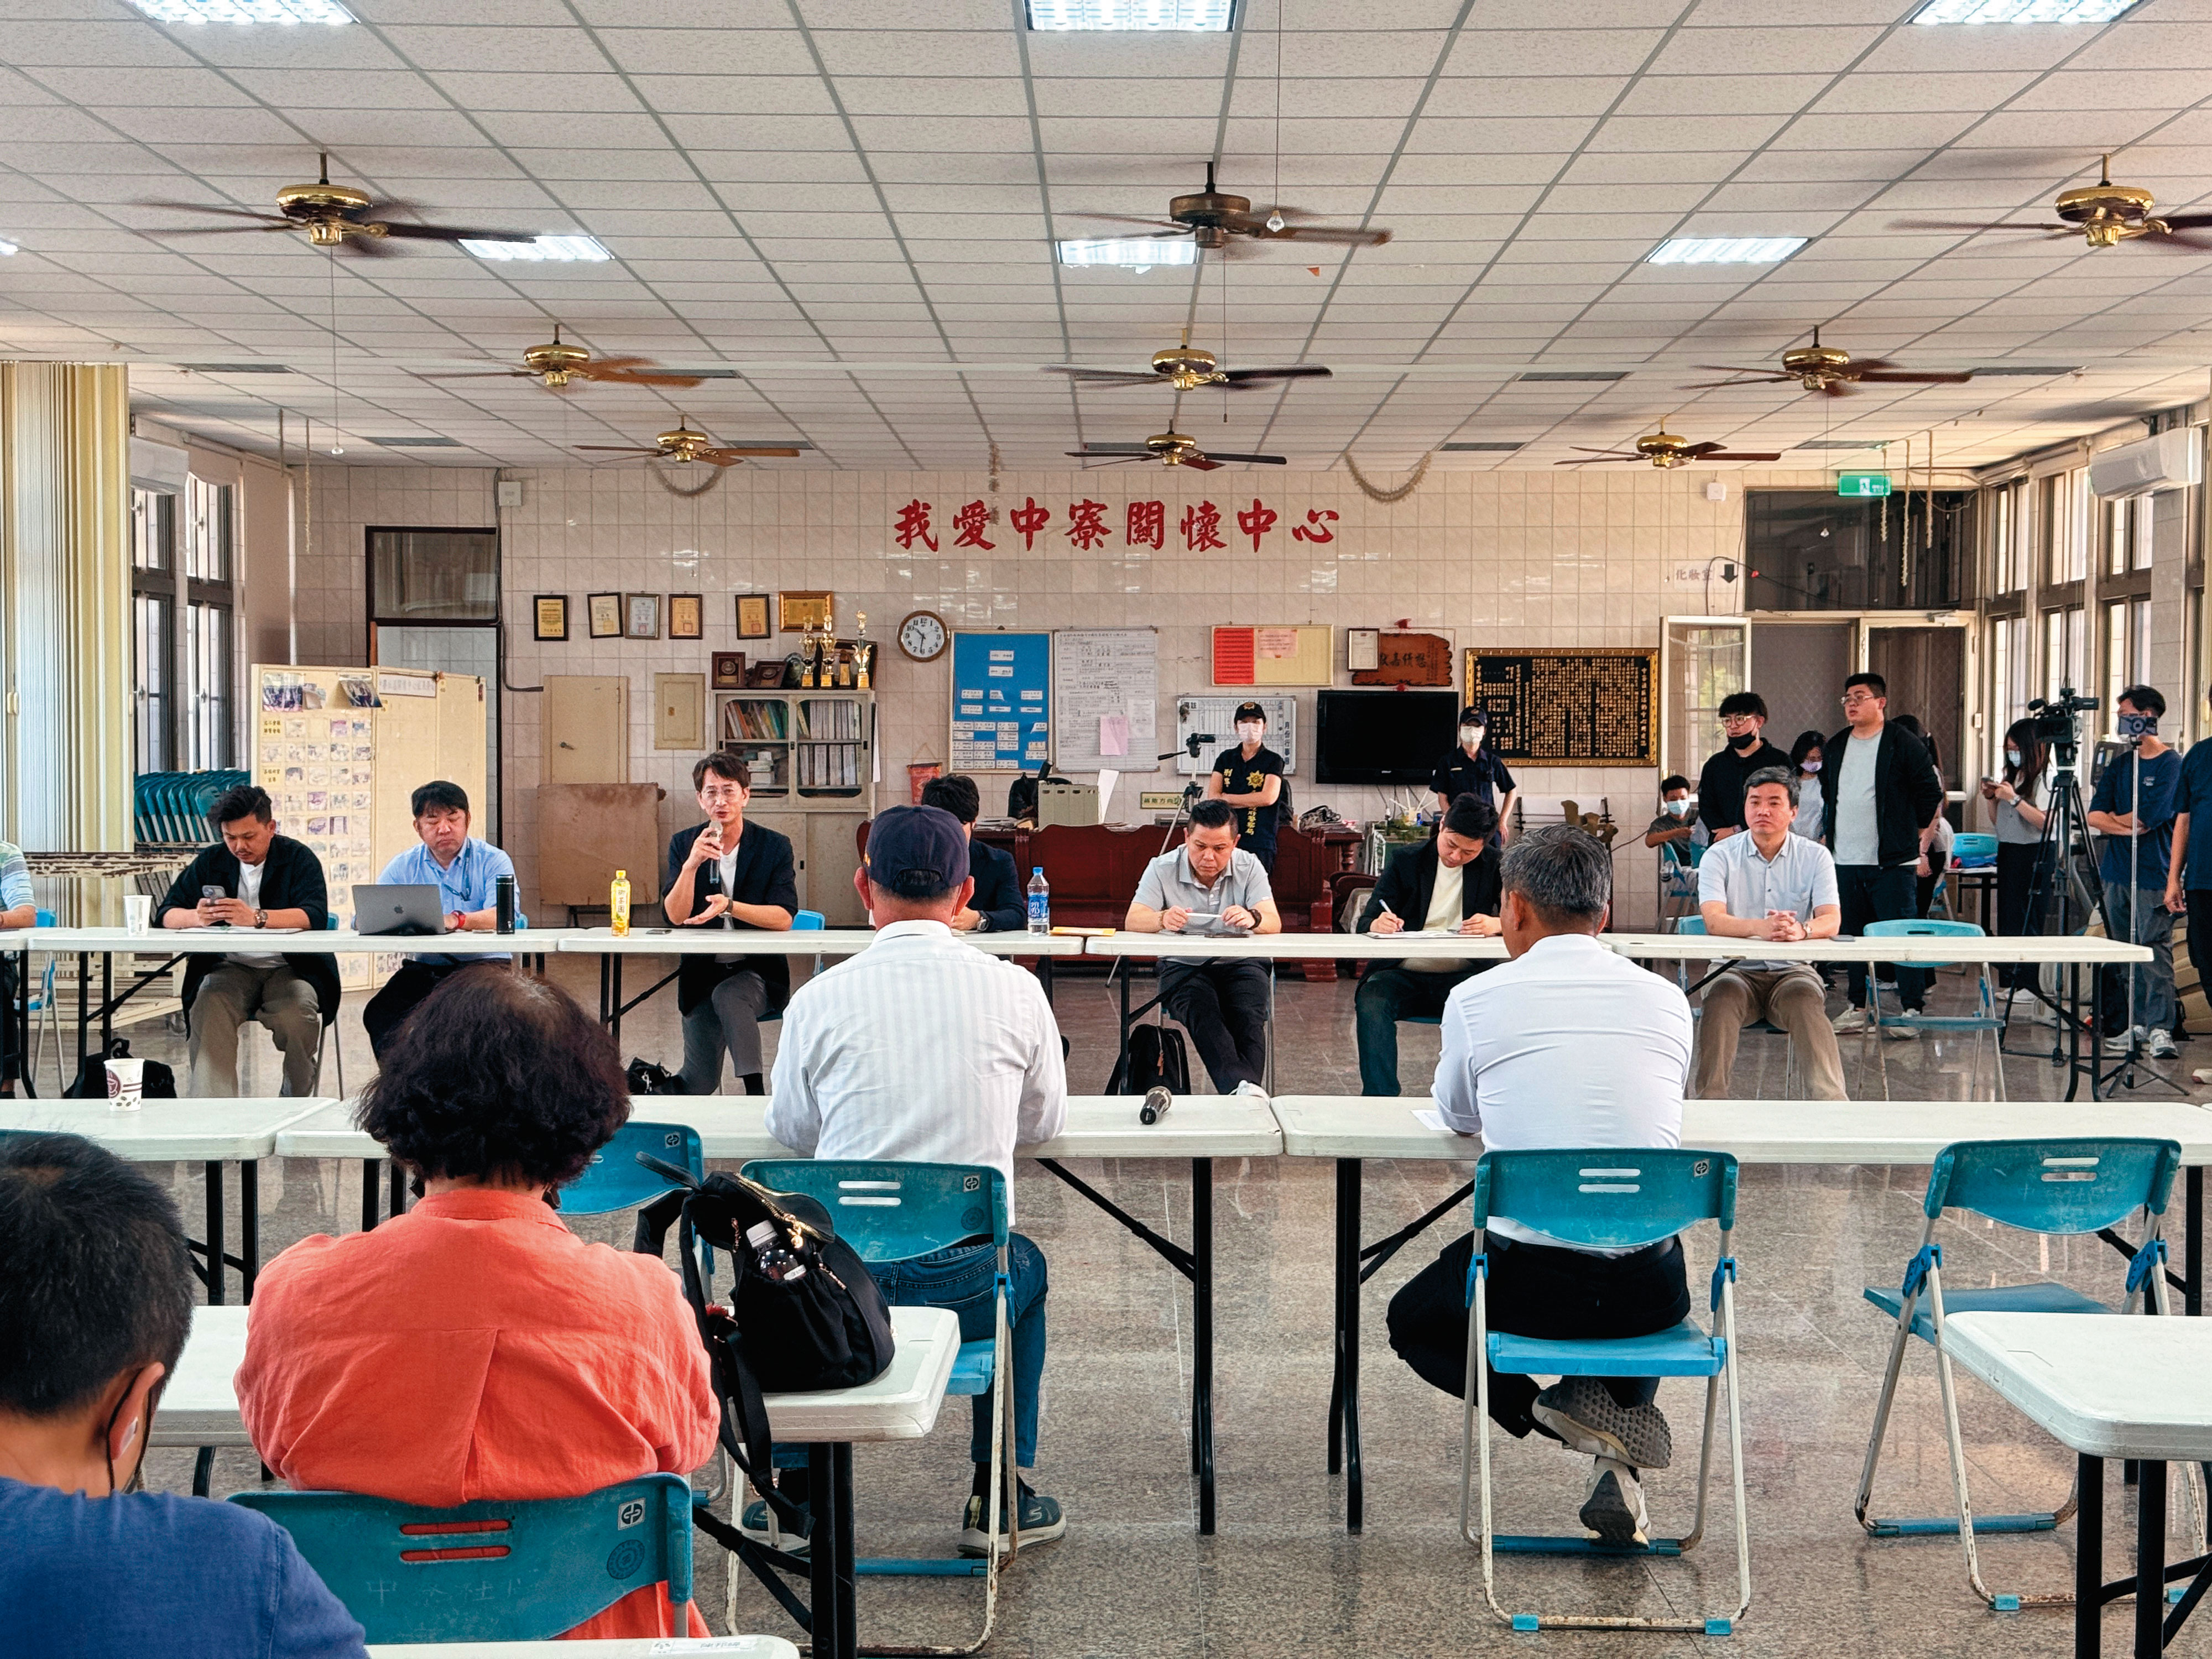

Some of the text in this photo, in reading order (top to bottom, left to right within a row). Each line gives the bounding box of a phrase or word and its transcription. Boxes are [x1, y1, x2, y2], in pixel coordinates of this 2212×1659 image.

[893, 496, 1340, 553] 我愛中寮關懷中心
